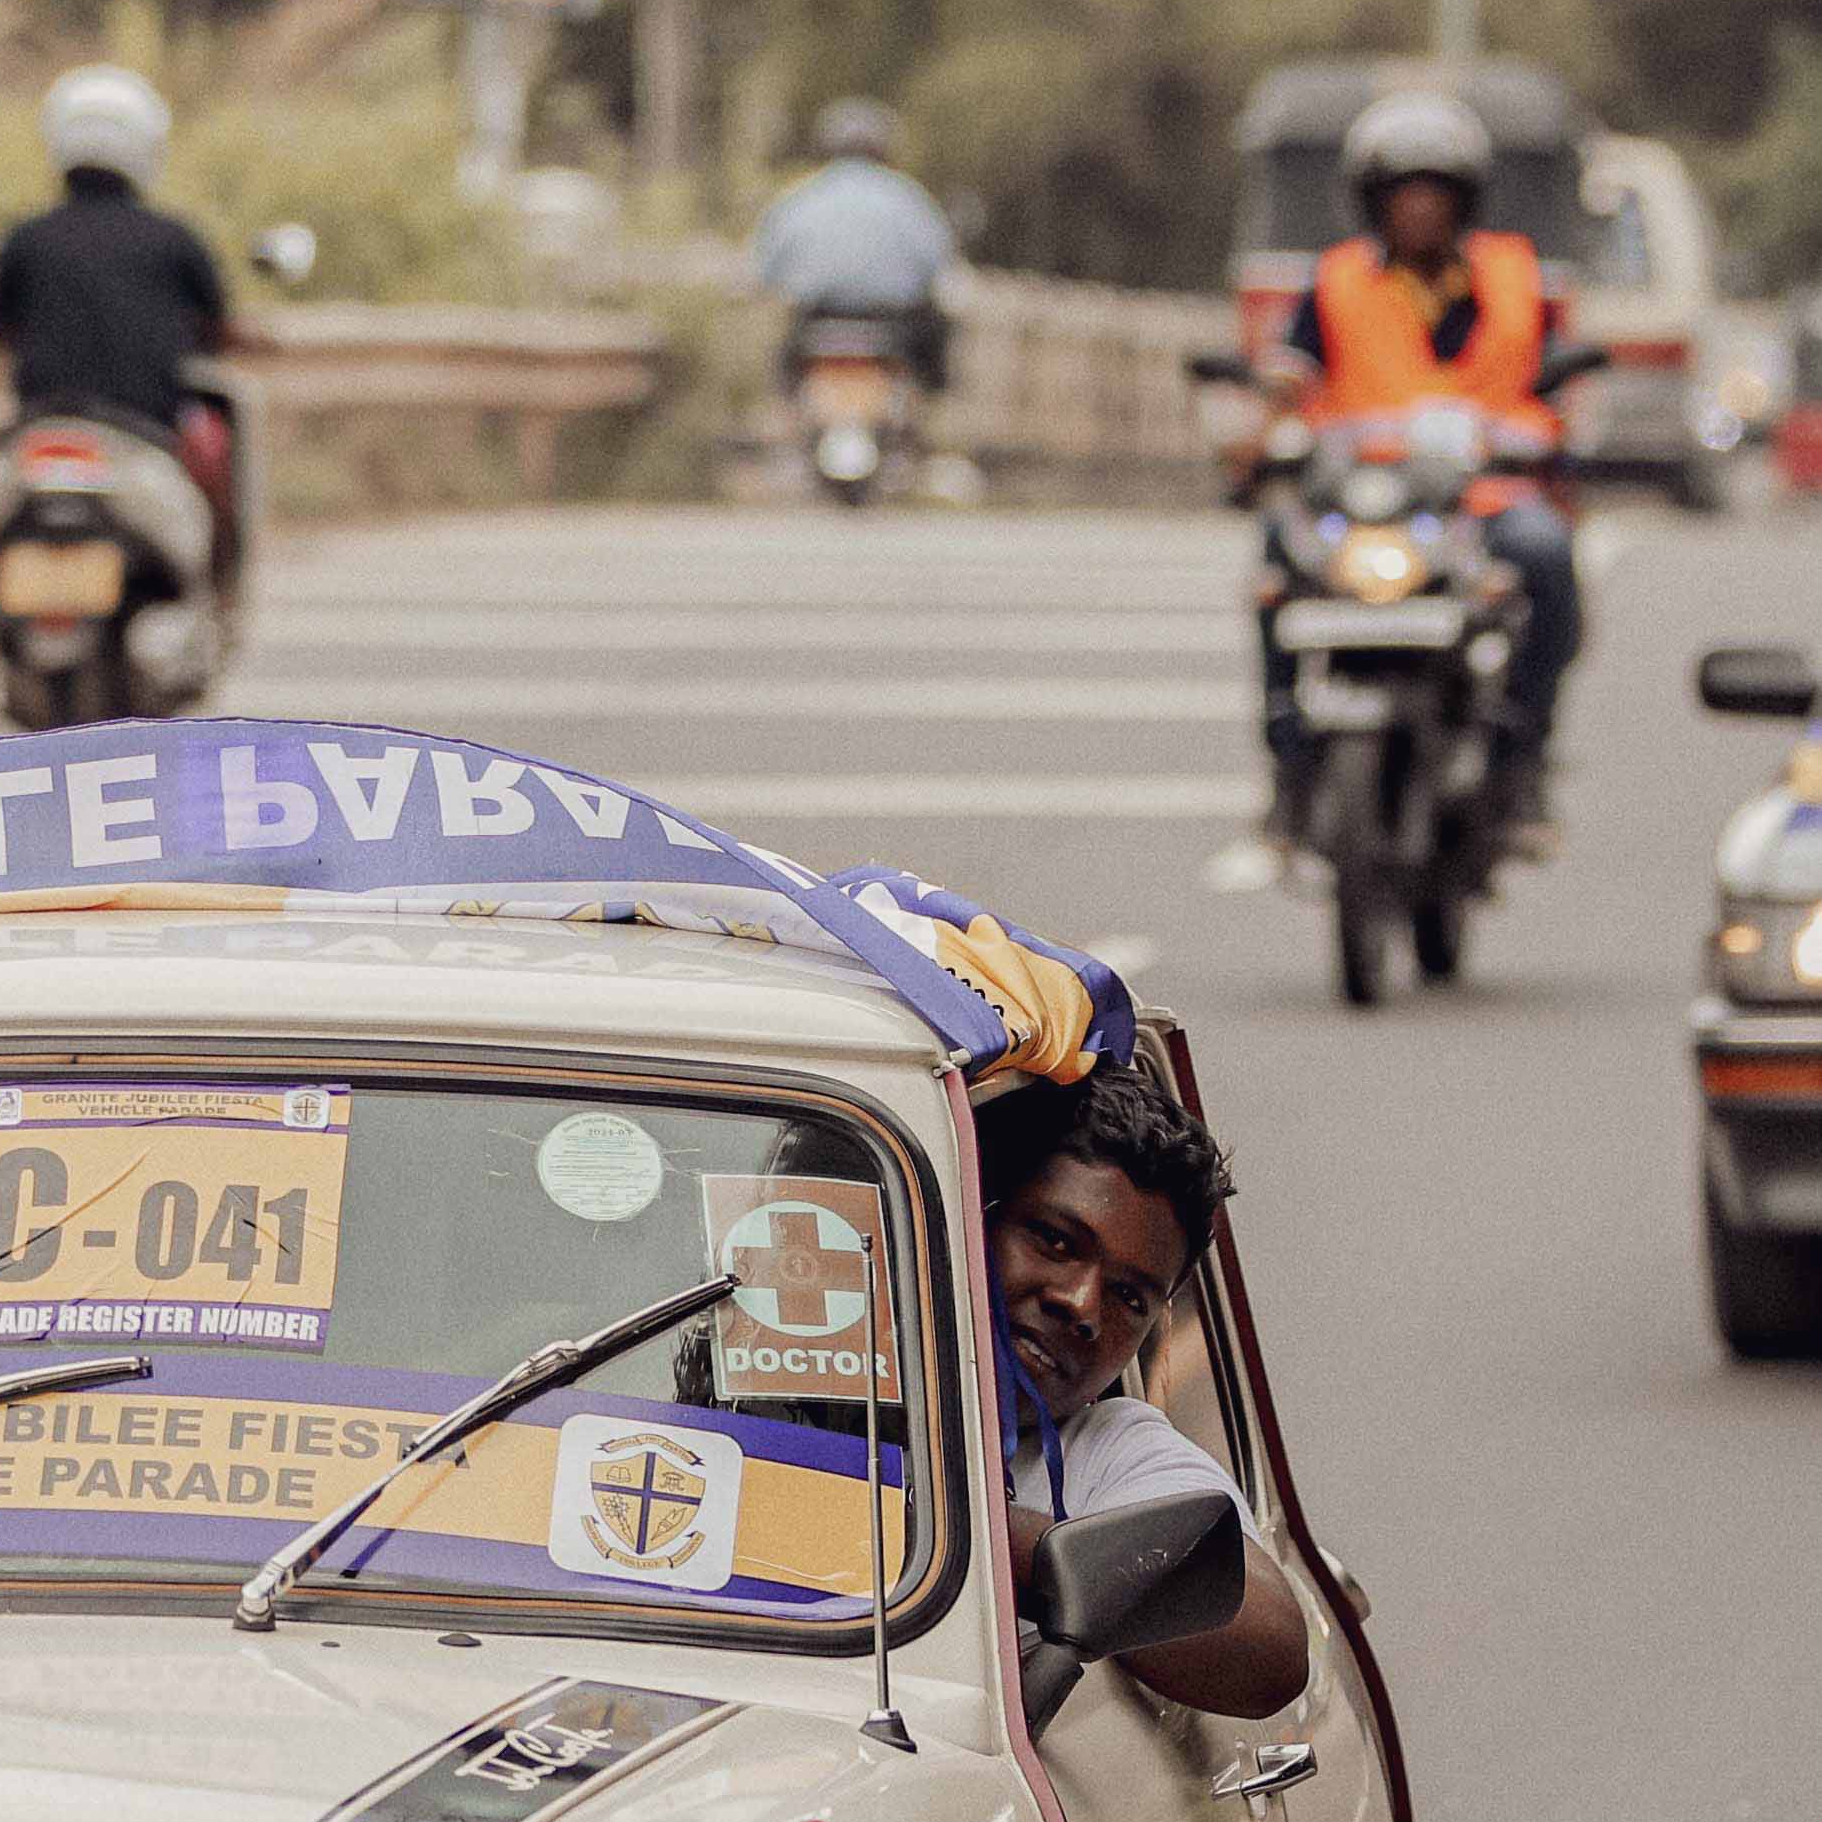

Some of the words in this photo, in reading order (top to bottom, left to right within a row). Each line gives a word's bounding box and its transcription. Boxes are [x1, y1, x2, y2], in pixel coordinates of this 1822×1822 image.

[42, 1093, 118, 1104] GRANITE
[126, 1093, 198, 1105] JUBILEE
[204, 1093, 263, 1106] FIESTA
[78, 1105, 156, 1116] VEHICLE
[159, 1106, 226, 1116] PARADE
[58, 1305, 195, 1335] REGISTER
[199, 1307, 320, 1342] NUMBER
[726, 1347, 891, 1378] DOCTOR
[39, 1456, 317, 1510] PARADE
